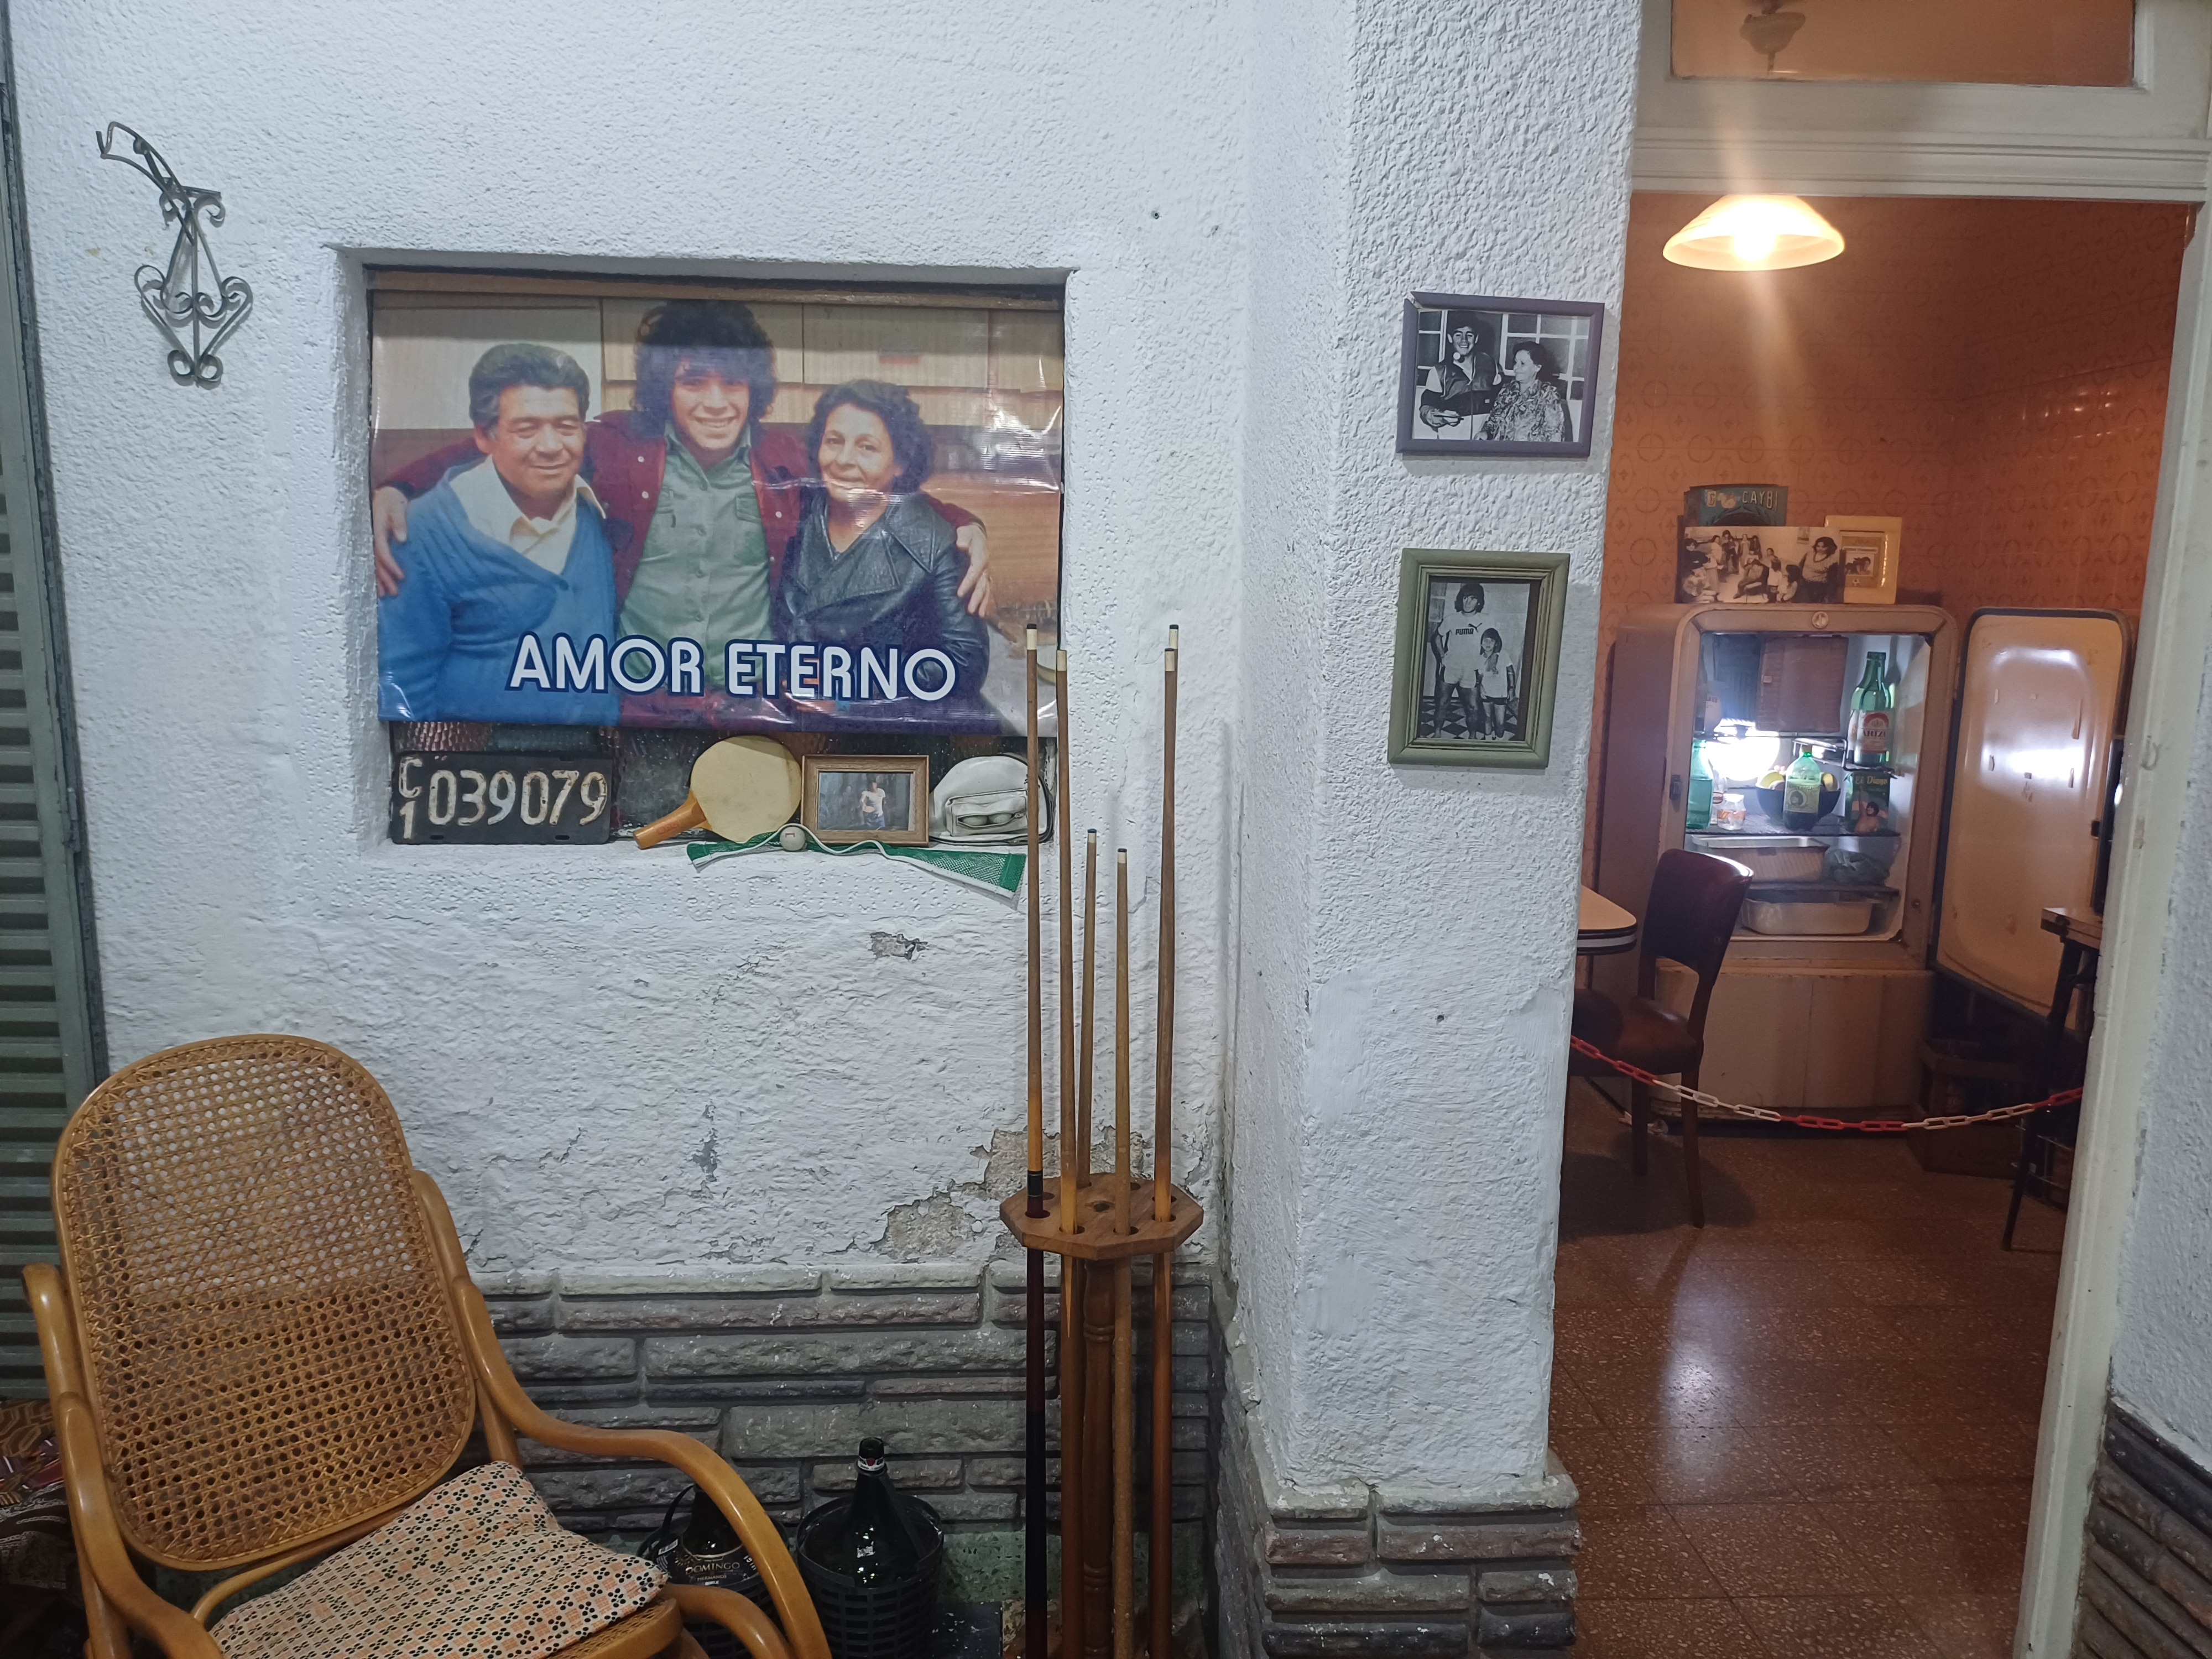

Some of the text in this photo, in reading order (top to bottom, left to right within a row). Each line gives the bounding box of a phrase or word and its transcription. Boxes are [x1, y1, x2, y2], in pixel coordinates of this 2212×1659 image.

[505, 630, 958, 701] AMOR ETERNO
[428, 769, 608, 826] 039079
[686, 1562, 740, 1575] DOMINGO
